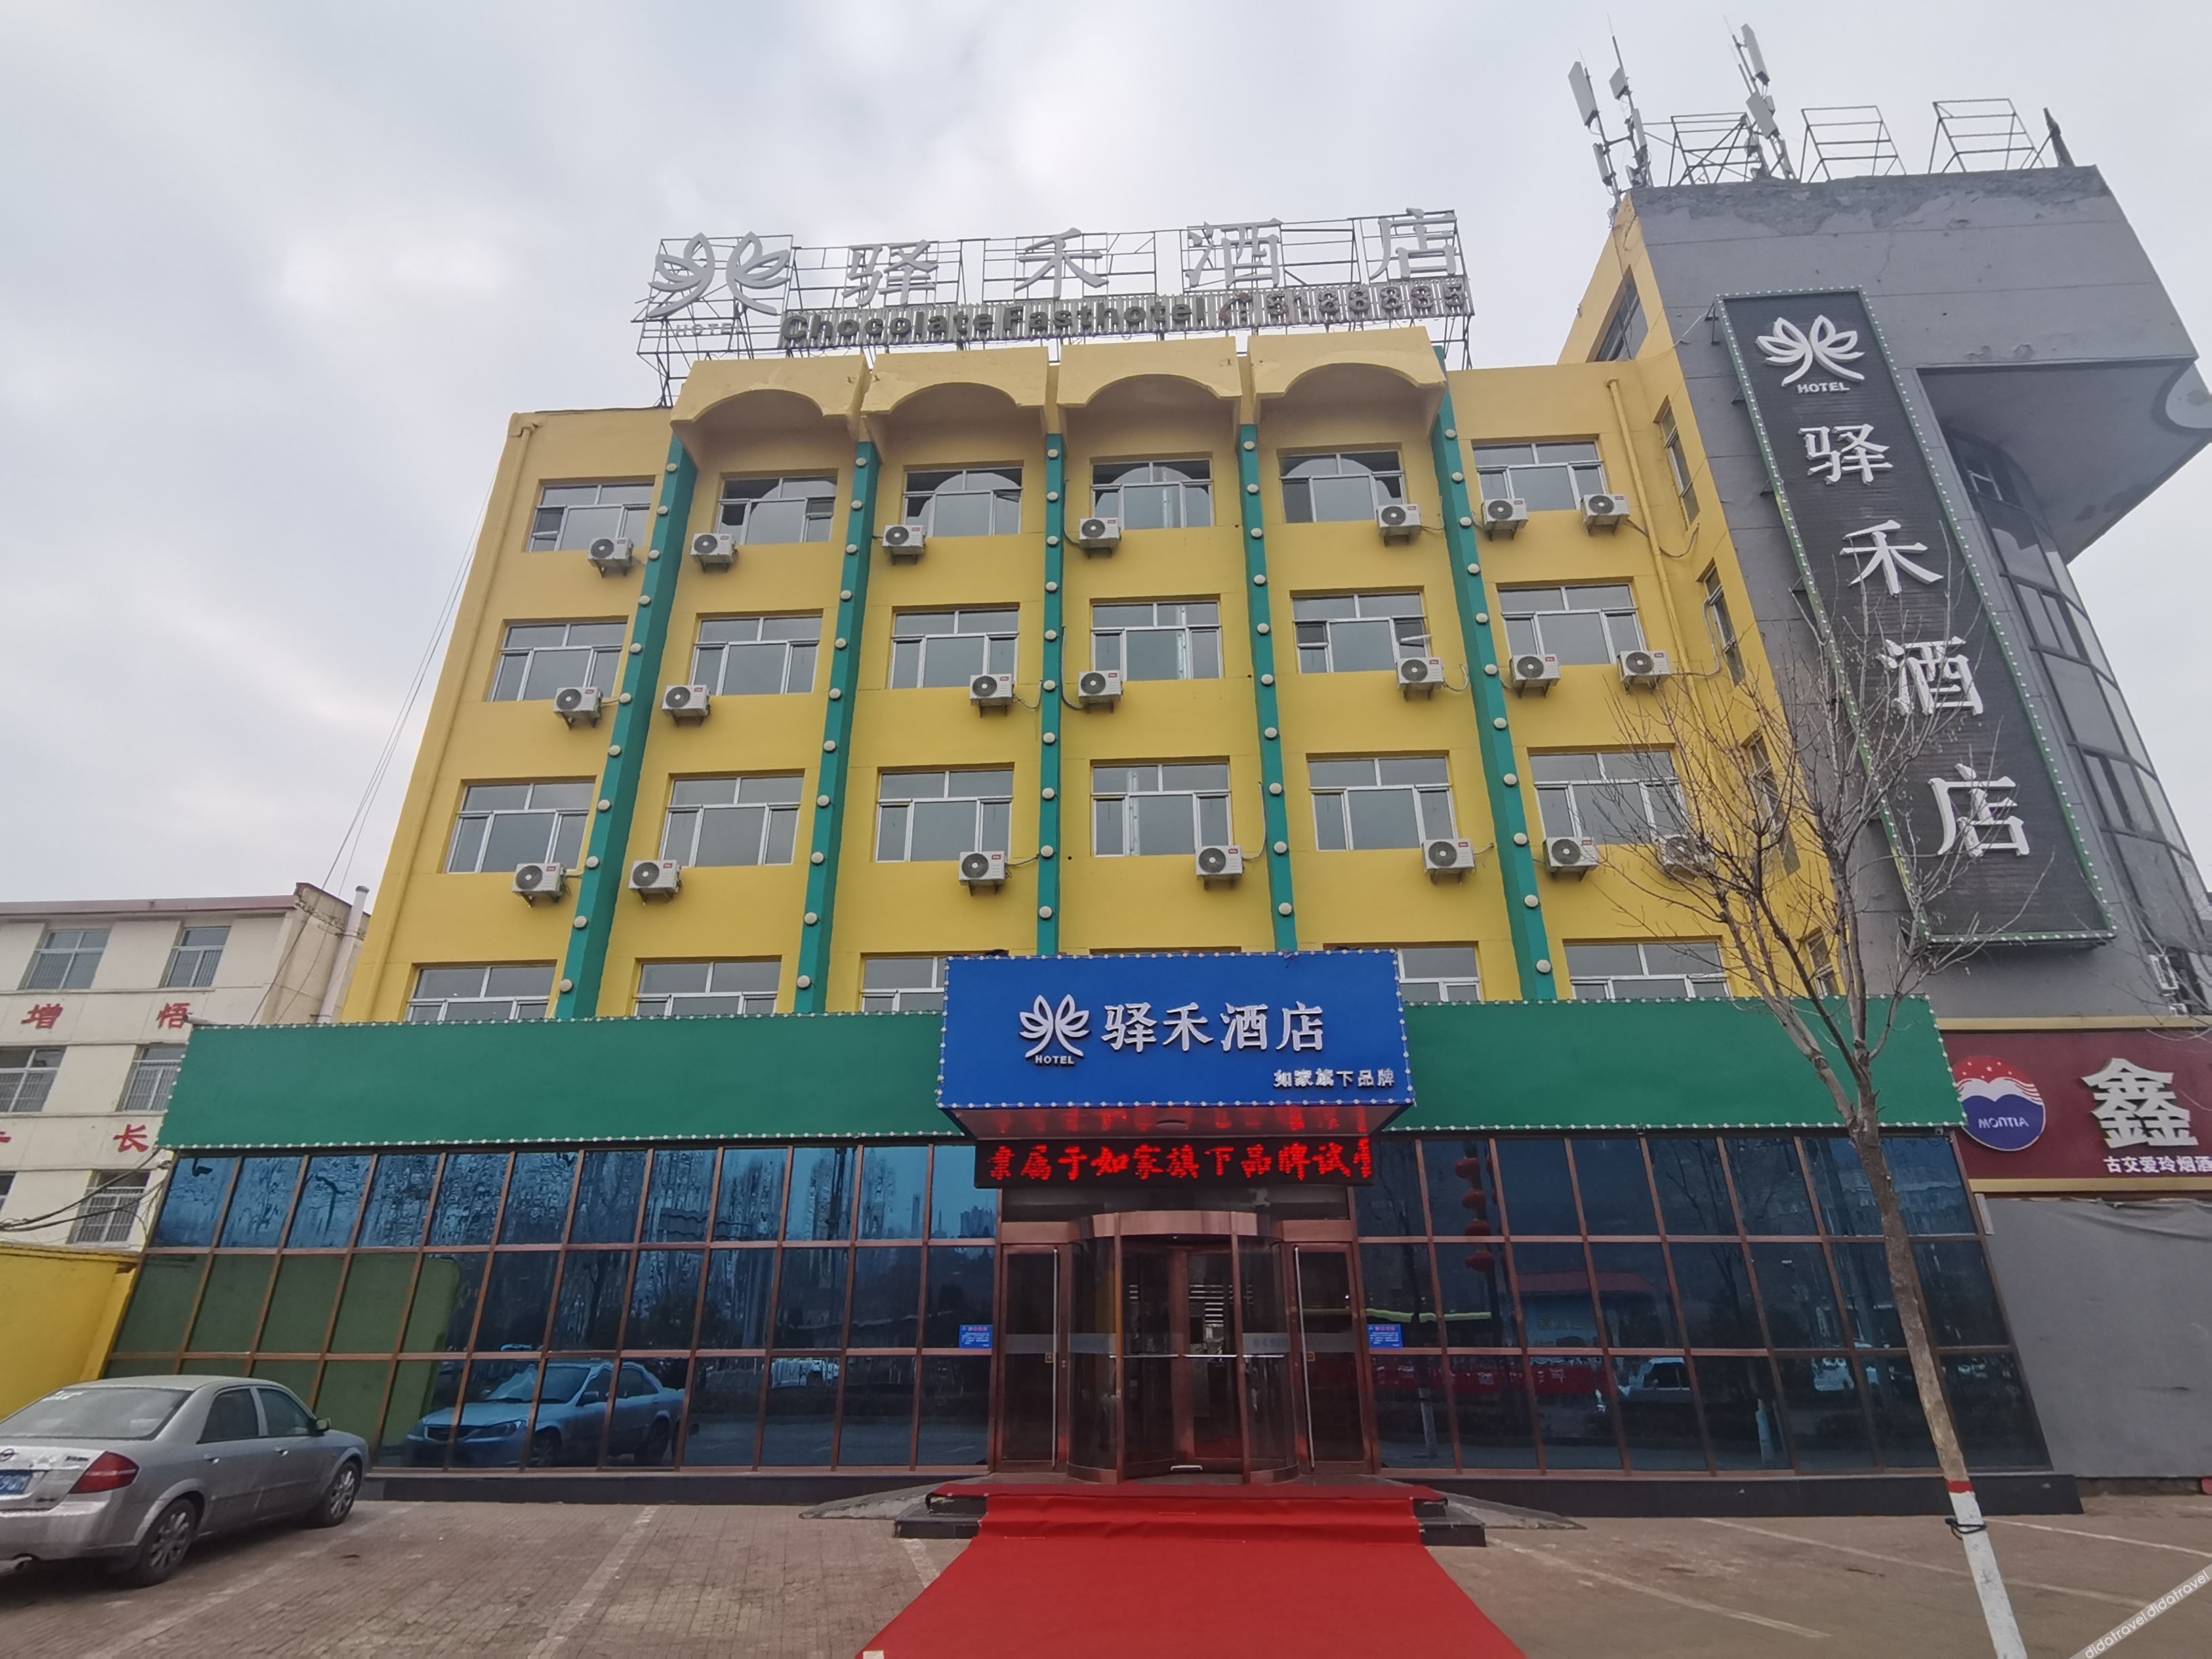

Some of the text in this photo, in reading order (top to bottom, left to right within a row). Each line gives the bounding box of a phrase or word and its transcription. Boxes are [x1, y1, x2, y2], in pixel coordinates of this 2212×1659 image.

[842, 208, 1458, 308] 驿禾酒店
[675, 321, 745, 337] HOTEL
[781, 309, 994, 340] Chocolate
[1003, 297, 1206, 331] Fasthotel
[1797, 382, 1851, 394] HOTEL
[1798, 423, 2030, 857] 驿禾酒店
[21, 1003, 63, 1029] 增
[1101, 1001, 1324, 1052] 驿禾酒店
[1035, 1054, 1075, 1065] HOTEL
[1273, 1068, 1395, 1088] 如家旗下品牌
[2081, 1057, 2199, 1149] 鑫
[112, 1124, 150, 1153] 长
